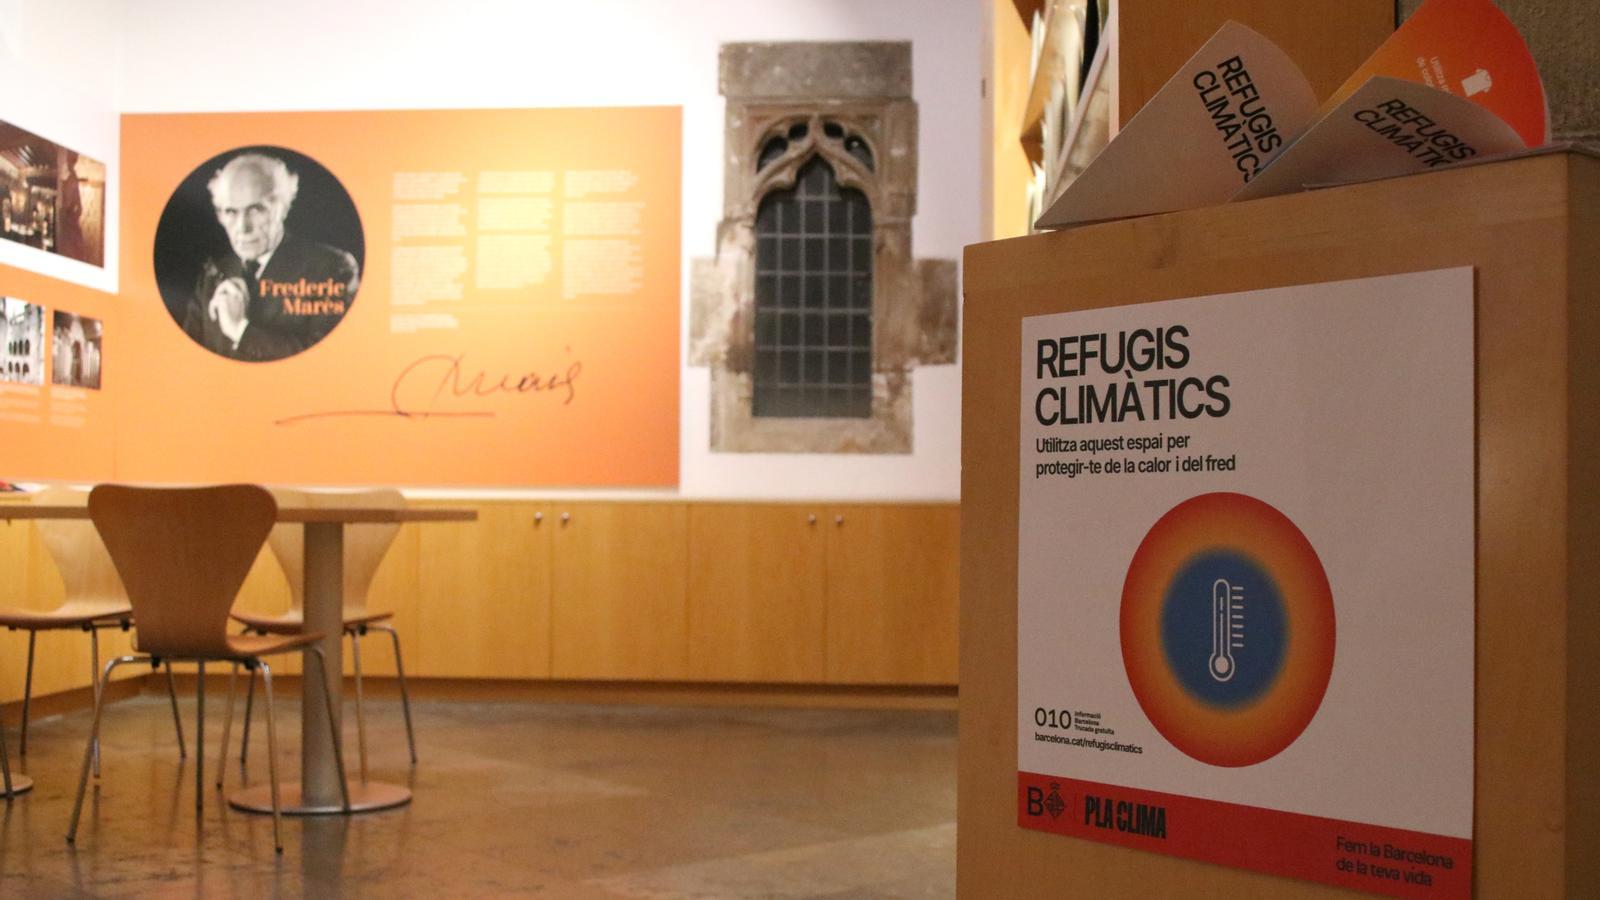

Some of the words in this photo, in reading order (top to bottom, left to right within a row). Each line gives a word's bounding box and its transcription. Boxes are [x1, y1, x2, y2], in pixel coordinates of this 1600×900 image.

[1217, 55, 1282, 153] REFUGIS
[1377, 98, 1477, 160] REFUGIS
[259, 277, 345, 297] Frederic
[1036, 325, 1190, 379] REFUGIS
[1035, 370, 1231, 426] CLIMÀTICS
[1036, 437, 1078, 453] Utilitza
[1080, 435, 1124, 456] aquest
[1126, 433, 1163, 453] espai
[1167, 435, 1190, 453] per
[1036, 458, 1102, 479] protegir-te
[1104, 458, 1122, 473] de
[1124, 457, 1136, 473] la
[1138, 456, 1171, 473] calor
[1175, 456, 1180, 472] i
[1182, 455, 1203, 472] del
[1206, 455, 1236, 471] fred
[1034, 707, 1072, 730] 010
[1074, 717, 1100, 726] Barcelona
[1035, 732, 1143, 754] barcelona.cat/refugisclimatics
[1085, 795, 1114, 830] PLA
[1117, 800, 1167, 840] CLIMA
[1336, 836, 1368, 855] Fem
[1370, 841, 1381, 857] la
[1384, 844, 1453, 869] Barcelona
[1336, 857, 1354, 872] de
[1356, 860, 1368, 875] la
[1371, 863, 1400, 880] teva
[1403, 865, 1433, 886] vida
